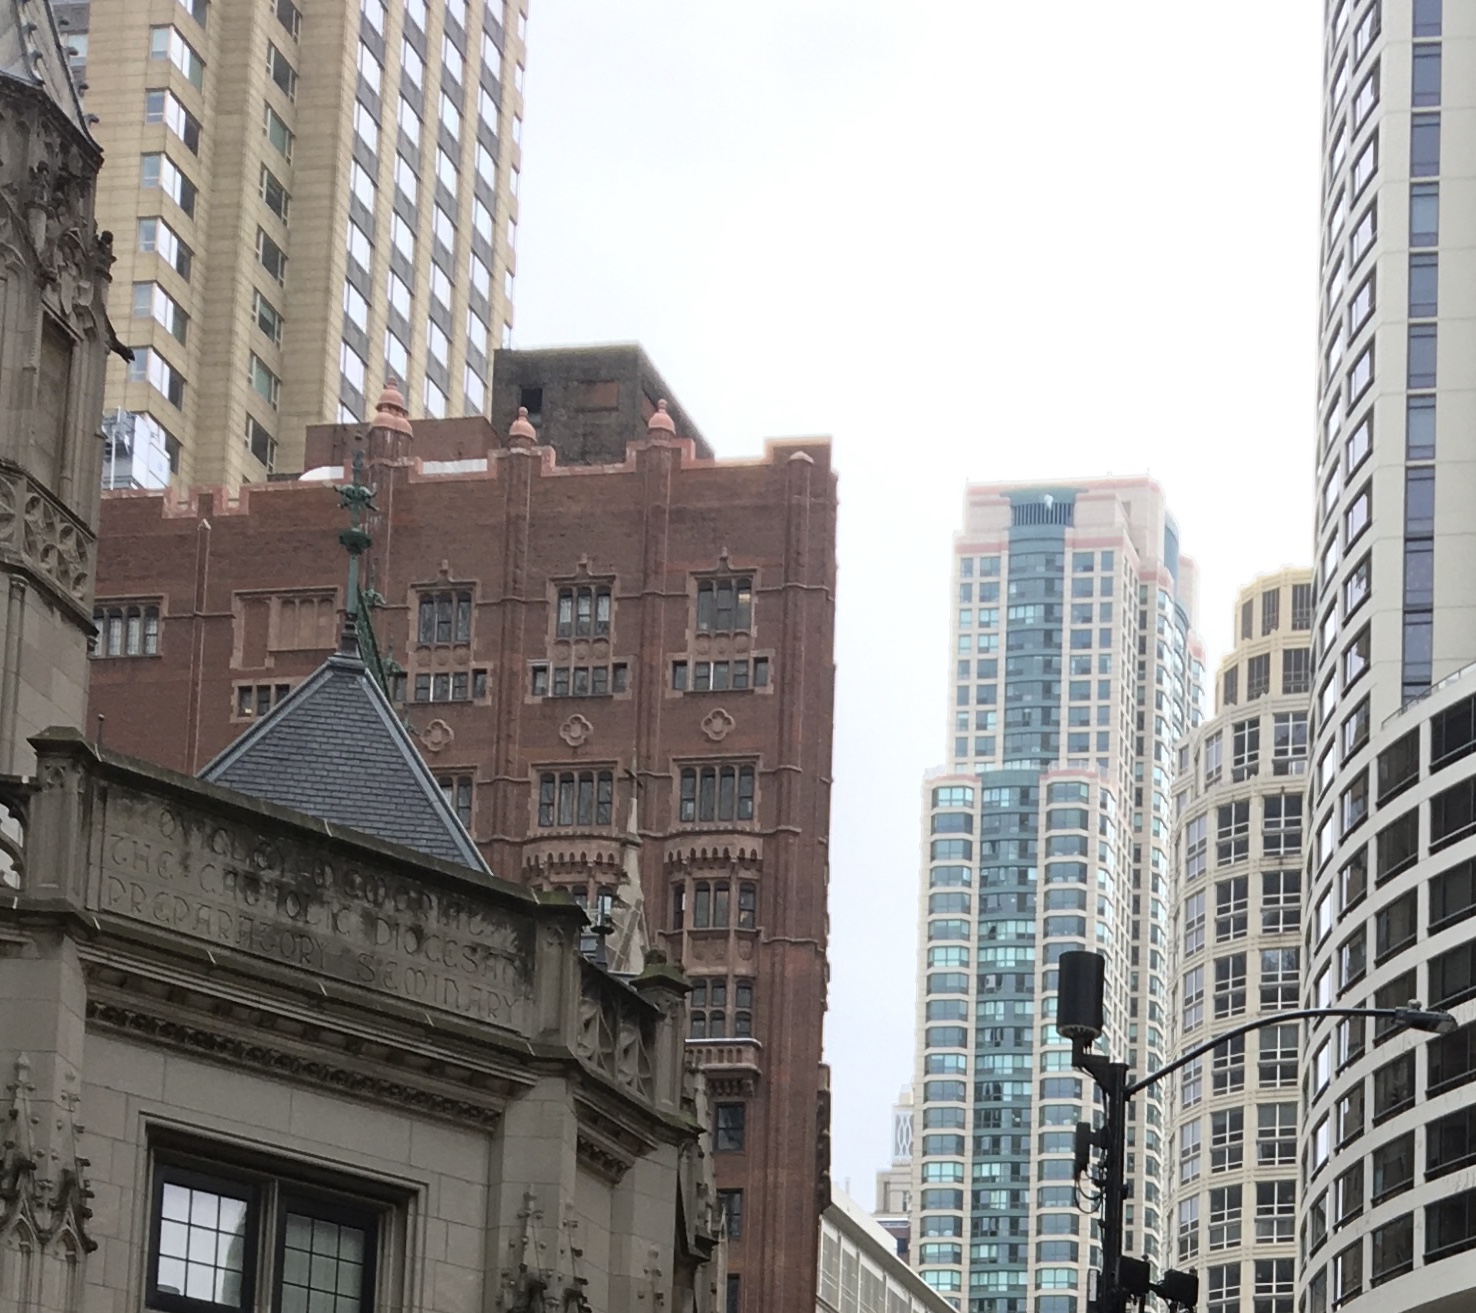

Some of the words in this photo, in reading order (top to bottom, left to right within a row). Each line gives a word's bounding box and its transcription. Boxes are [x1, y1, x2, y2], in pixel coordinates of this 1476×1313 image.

[107, 874, 328, 970] PREPARATORY
[356, 951, 519, 1024] SEMINARY
[110, 833, 174, 881] THE
[373, 915, 519, 990] DIOCESAN
